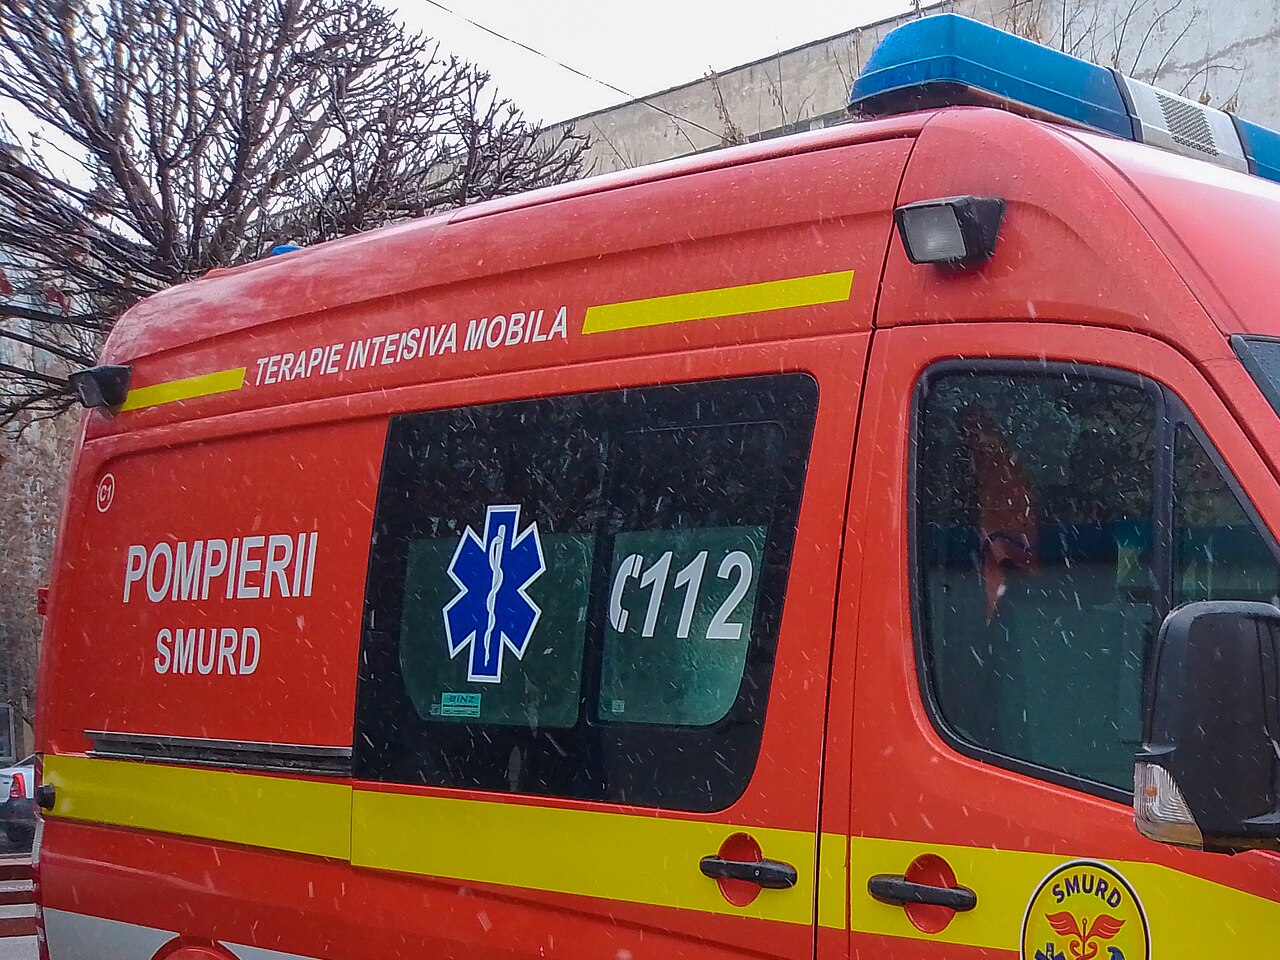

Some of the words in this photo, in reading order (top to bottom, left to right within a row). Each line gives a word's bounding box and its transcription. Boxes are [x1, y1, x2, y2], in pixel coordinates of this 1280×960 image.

[255, 343, 344, 386] TERAPIE
[463, 306, 567, 351] MOBILA
[123, 532, 318, 603] POMPIERII
[639, 550, 753, 640] 112
[154, 627, 261, 675] SMURD
[1052, 874, 1122, 908] SMURD
